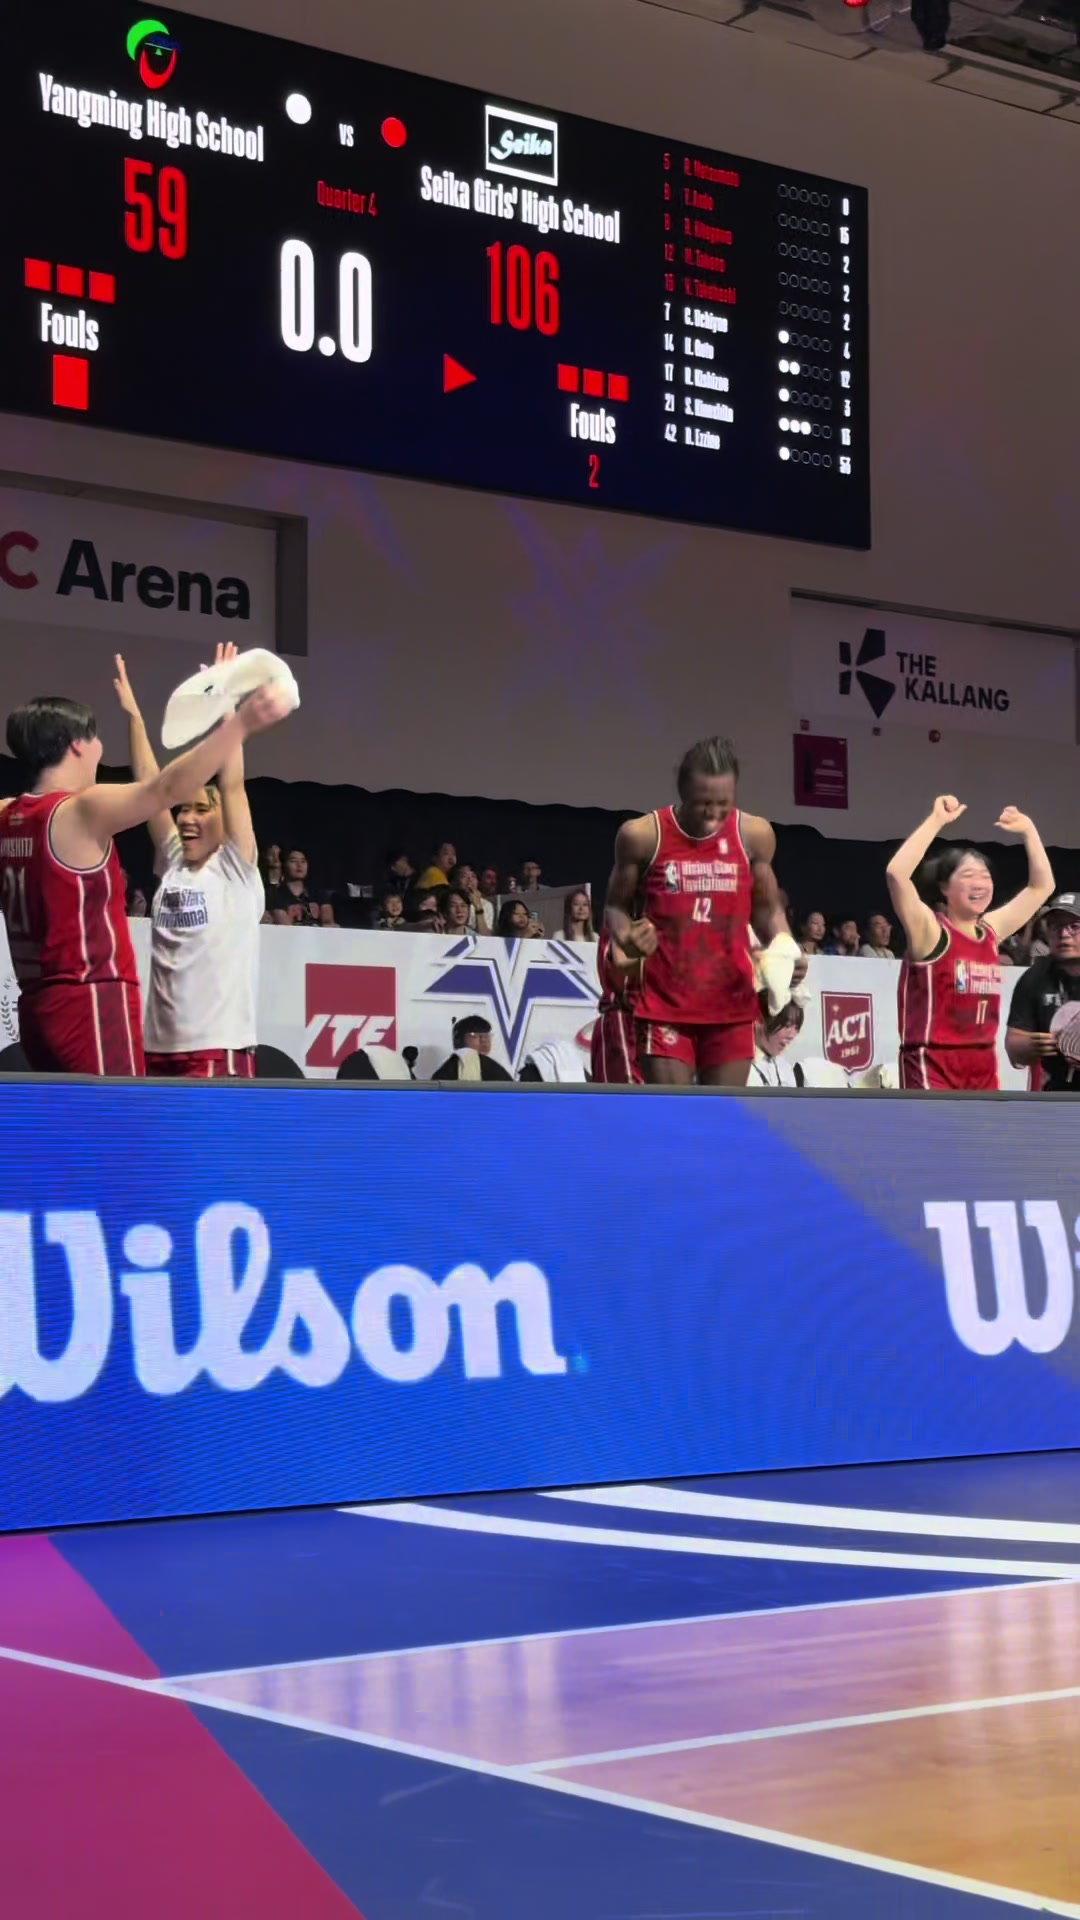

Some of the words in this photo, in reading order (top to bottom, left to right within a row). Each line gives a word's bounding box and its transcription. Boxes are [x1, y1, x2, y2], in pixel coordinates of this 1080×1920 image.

[39, 72, 143, 140] Yangming
[146, 99, 192, 149] High
[196, 111, 264, 162] School
[124, 157, 188, 261] 59
[317, 180, 366, 214] Quarter
[368, 192, 378, 217] 4
[420, 165, 470, 210] Seika
[474, 177, 518, 220] Girls'
[521, 189, 559, 234] High
[562, 199, 620, 244] School
[664, 243, 675, 262] 12
[843, 256, 850, 273] 2
[281, 239, 373, 363] 0.0
[486, 241, 560, 337] 106
[843, 285, 850, 303] 2
[664, 302, 671, 321] 7
[843, 313, 850, 331] 2
[41, 302, 99, 352] Fouls
[664, 333, 674, 352] 14
[664, 363, 674, 382] 17
[664, 393, 675, 412] 21
[844, 399, 851, 417] 3
[570, 403, 616, 445] Fouls
[664, 423, 677, 442] 42
[588, 454, 599, 489] 2
[56, 538, 250, 620] Arena
[896, 651, 936, 677] THE
[905, 678, 1010, 712] KALLANG
[692, 897, 712, 923] 42
[975, 1000, 989, 1025] 17
[305, 1014, 395, 1060] ITE
[825, 1011, 870, 1048] ACT
